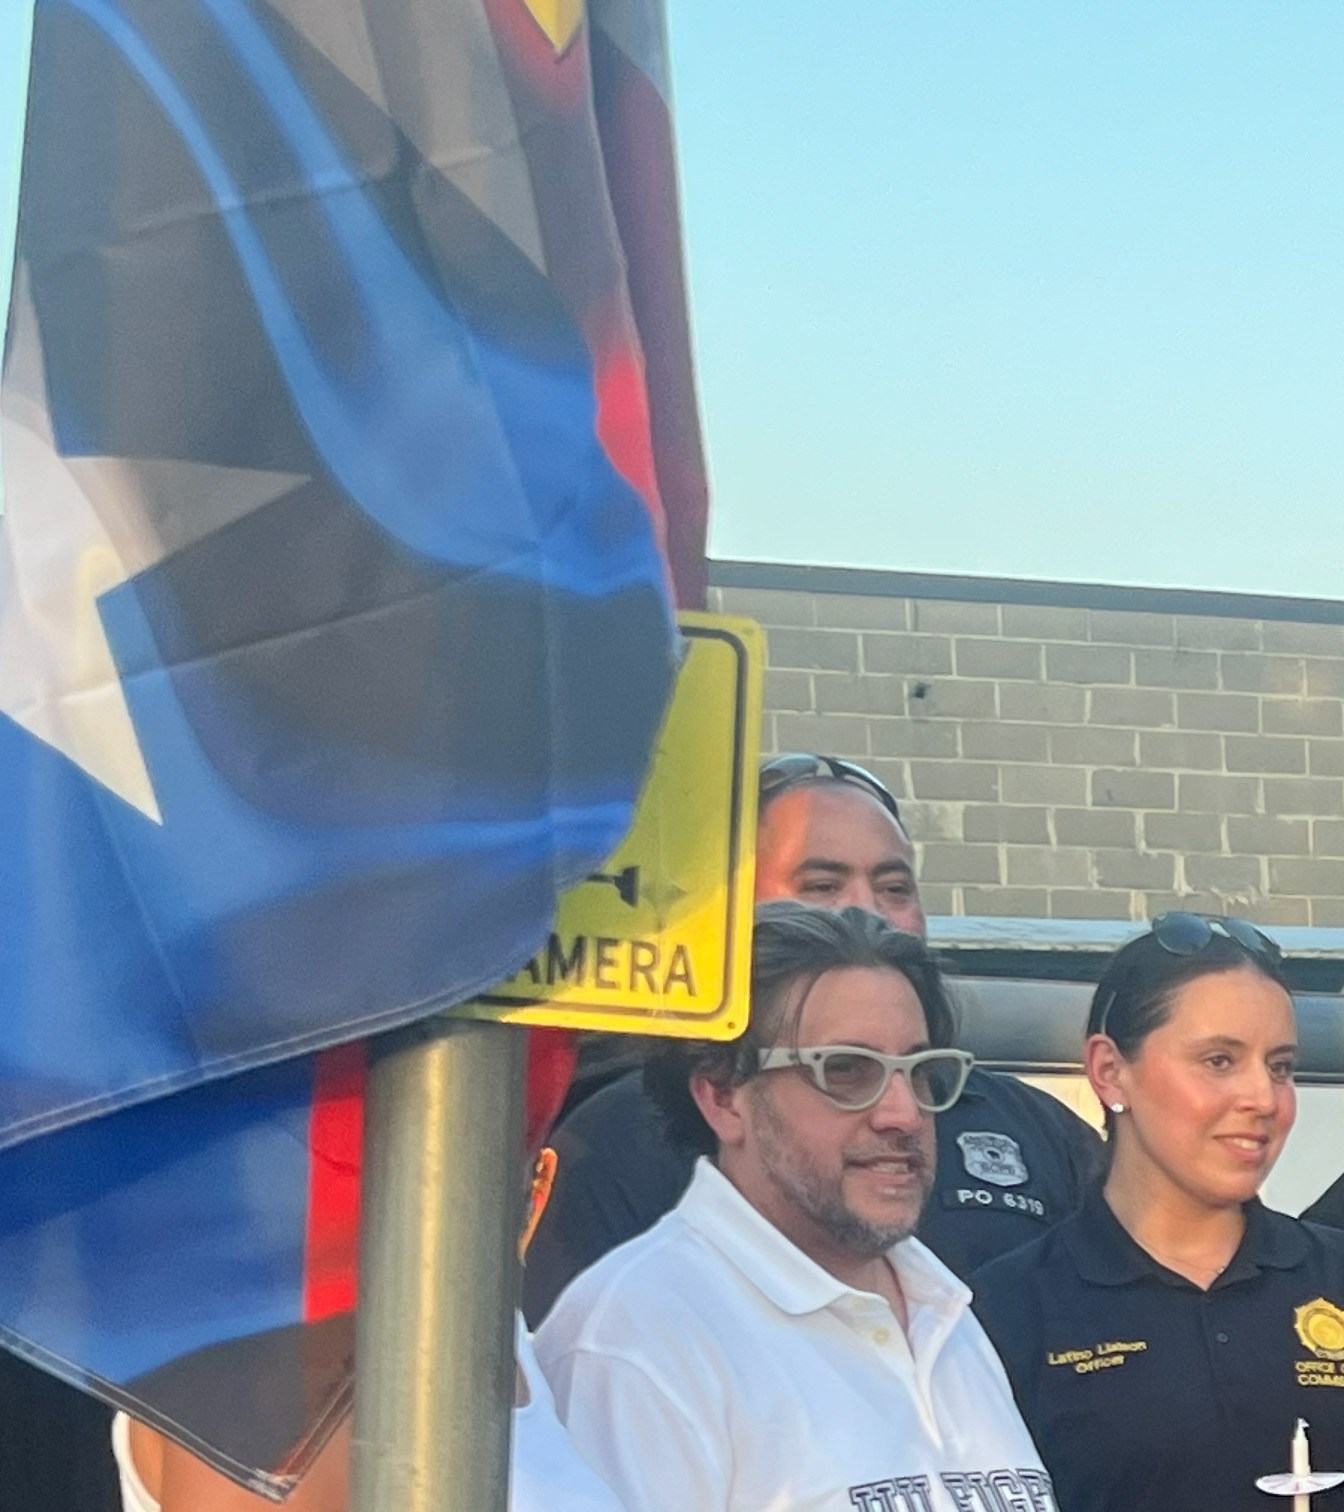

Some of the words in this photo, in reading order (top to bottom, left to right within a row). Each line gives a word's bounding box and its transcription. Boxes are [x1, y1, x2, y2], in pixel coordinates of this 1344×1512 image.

[504, 932, 697, 997] AMERA
[957, 1189, 993, 1204] PO
[1075, 1355, 1125, 1374] Officer
